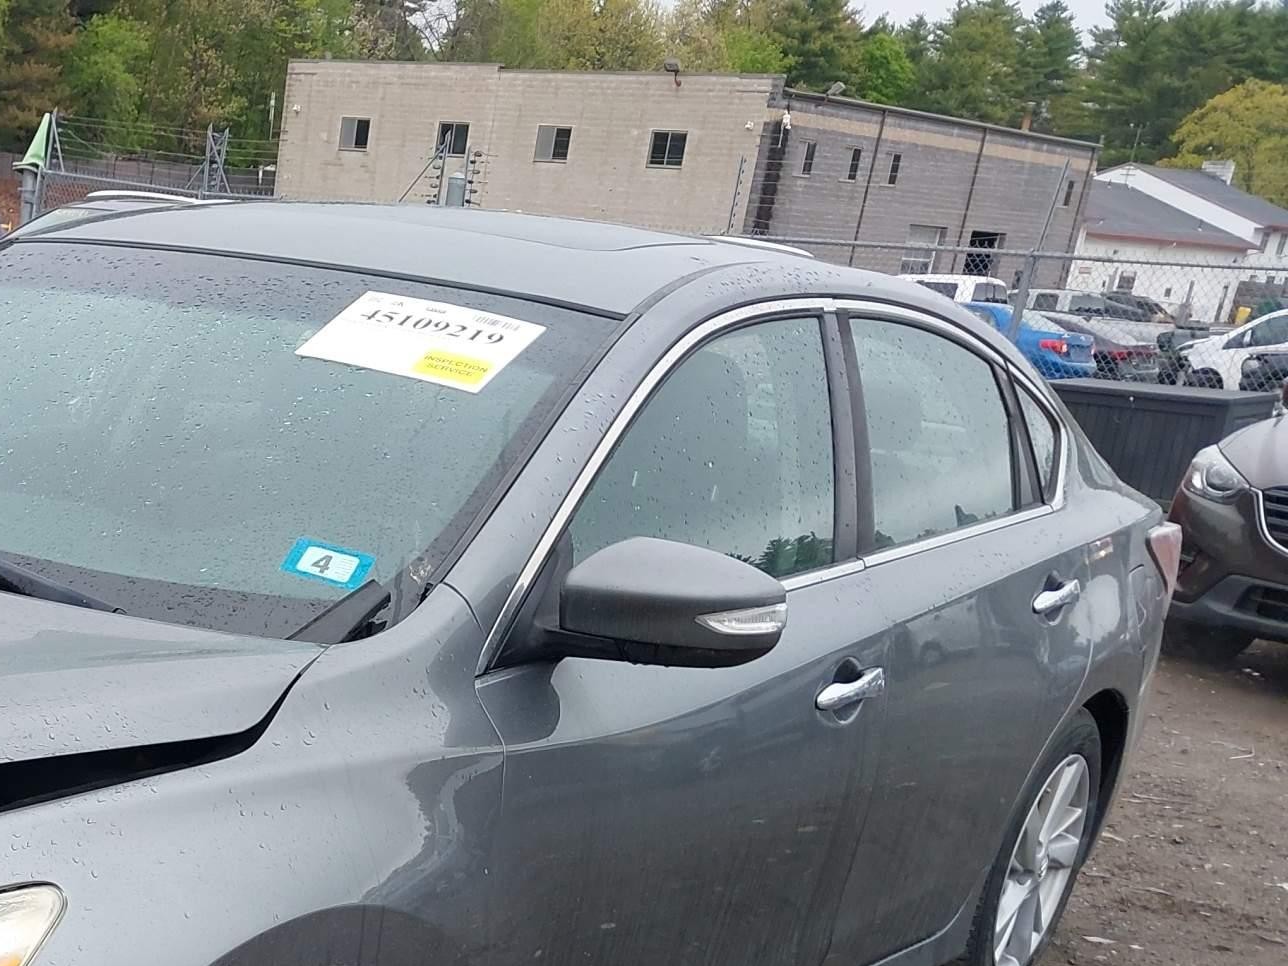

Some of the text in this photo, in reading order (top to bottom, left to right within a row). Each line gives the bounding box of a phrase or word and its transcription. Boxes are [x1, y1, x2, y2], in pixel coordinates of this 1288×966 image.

[361, 309, 504, 344] 45109219
[423, 354, 489, 373] INSPECTION
[425, 362, 474, 377] SERVICE
[311, 554, 333, 573] 4
